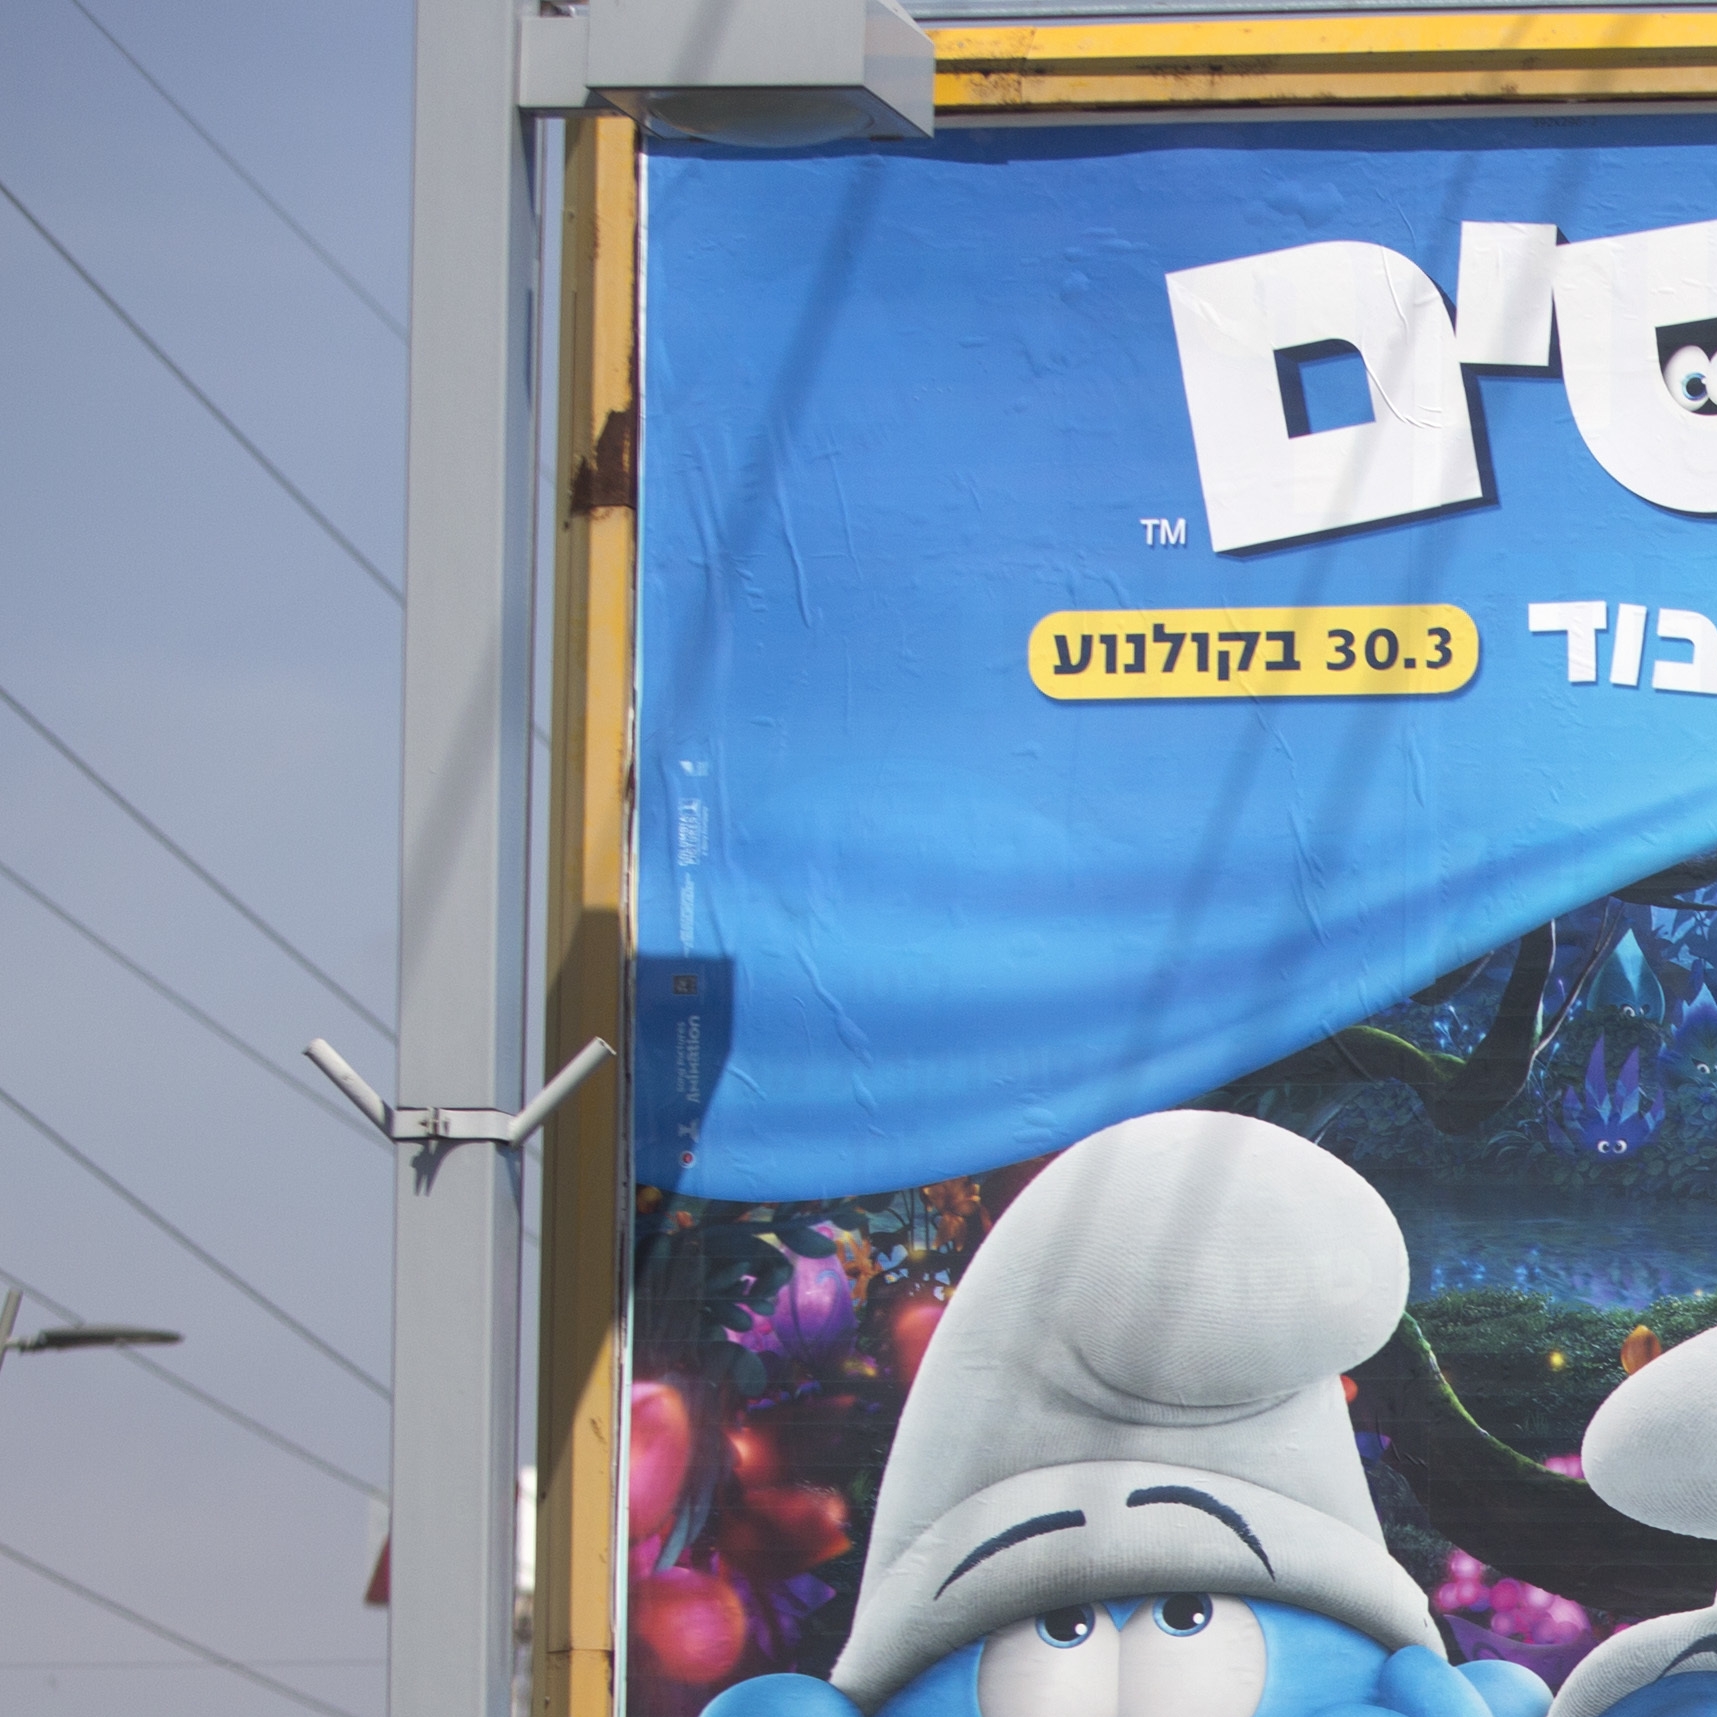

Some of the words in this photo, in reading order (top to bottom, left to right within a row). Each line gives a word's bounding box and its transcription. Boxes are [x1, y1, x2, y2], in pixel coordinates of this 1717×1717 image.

[1140, 517, 1187, 546] TM
[1053, 623, 1302, 681] בקולנוע
[1326, 627, 1453, 671] 30.3
